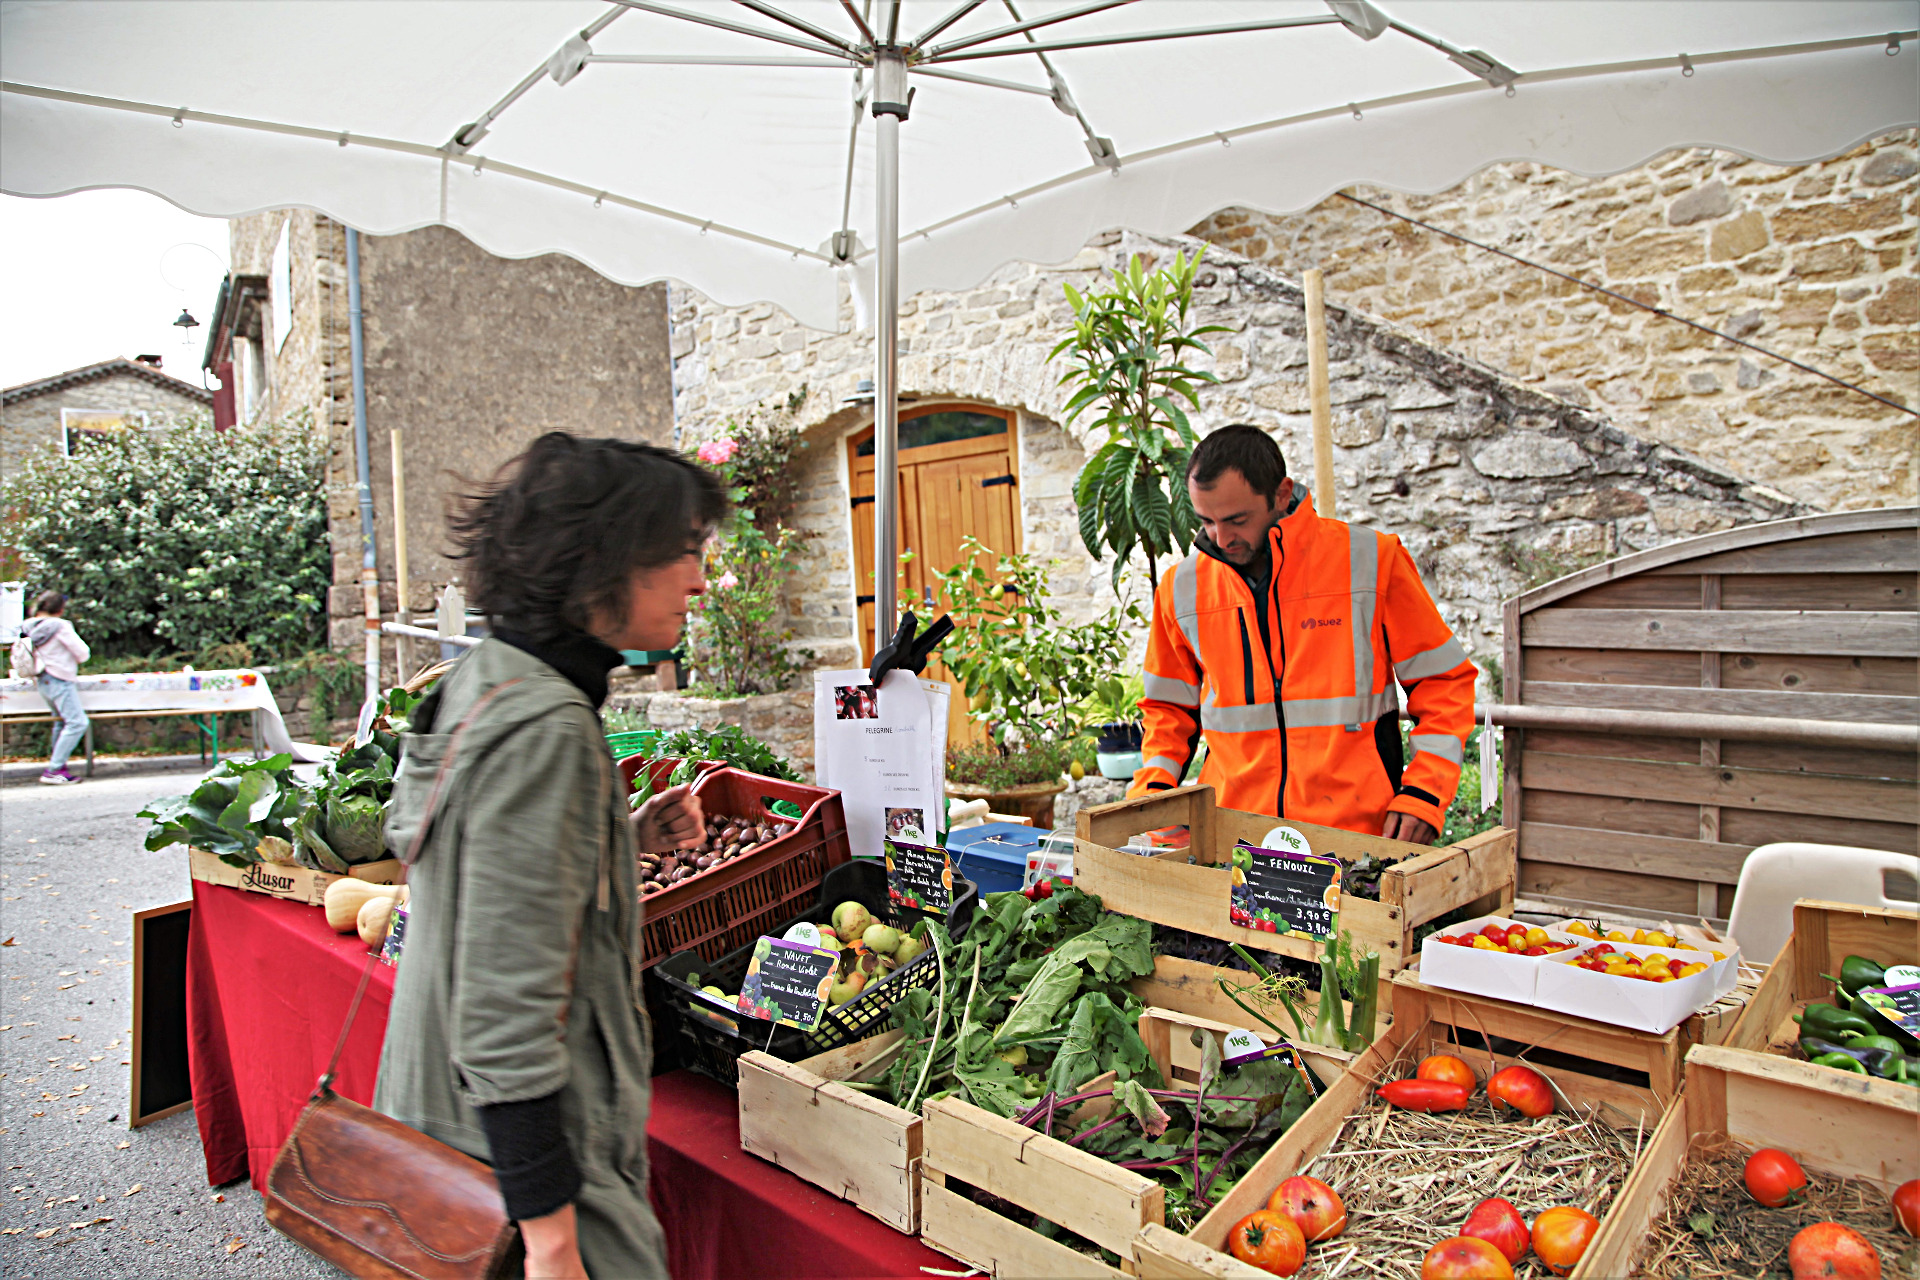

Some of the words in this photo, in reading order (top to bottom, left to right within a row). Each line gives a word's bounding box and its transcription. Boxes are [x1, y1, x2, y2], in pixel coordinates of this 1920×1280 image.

[1318, 618, 1342, 627] suez
[903, 828, 918, 839] 1kg
[1280, 830, 1302, 850] 1kg
[1270, 858, 1316, 875] FENOUIL
[1322, 910, 1331, 920] €
[795, 926, 812, 939] 1kg
[784, 950, 812, 963] NAVET
[776, 959, 797, 970] Rond
[798, 964, 818, 975] Violet
[1229, 1035, 1250, 1047] 1kg
